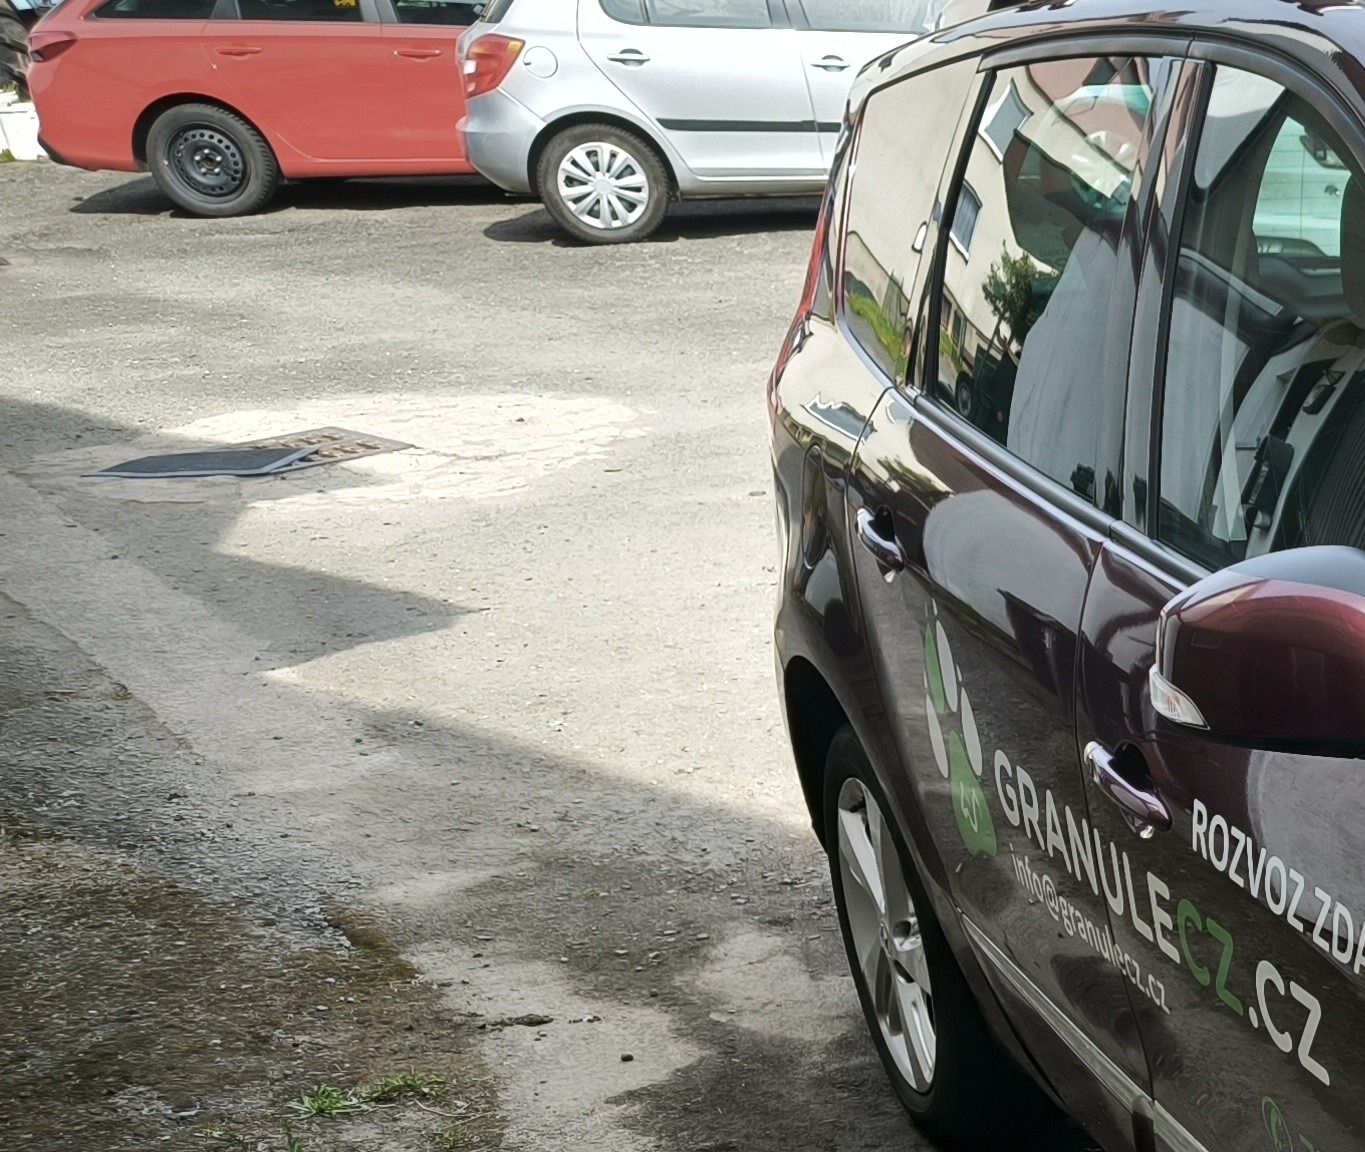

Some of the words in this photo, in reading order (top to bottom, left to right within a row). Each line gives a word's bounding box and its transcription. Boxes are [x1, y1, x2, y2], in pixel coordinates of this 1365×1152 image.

[994, 749, 1331, 1086] GRANULECZ.CZ
[1010, 842, 1170, 1015] info@granulecz.cz
[1191, 798, 1311, 934] ROZVOZ
